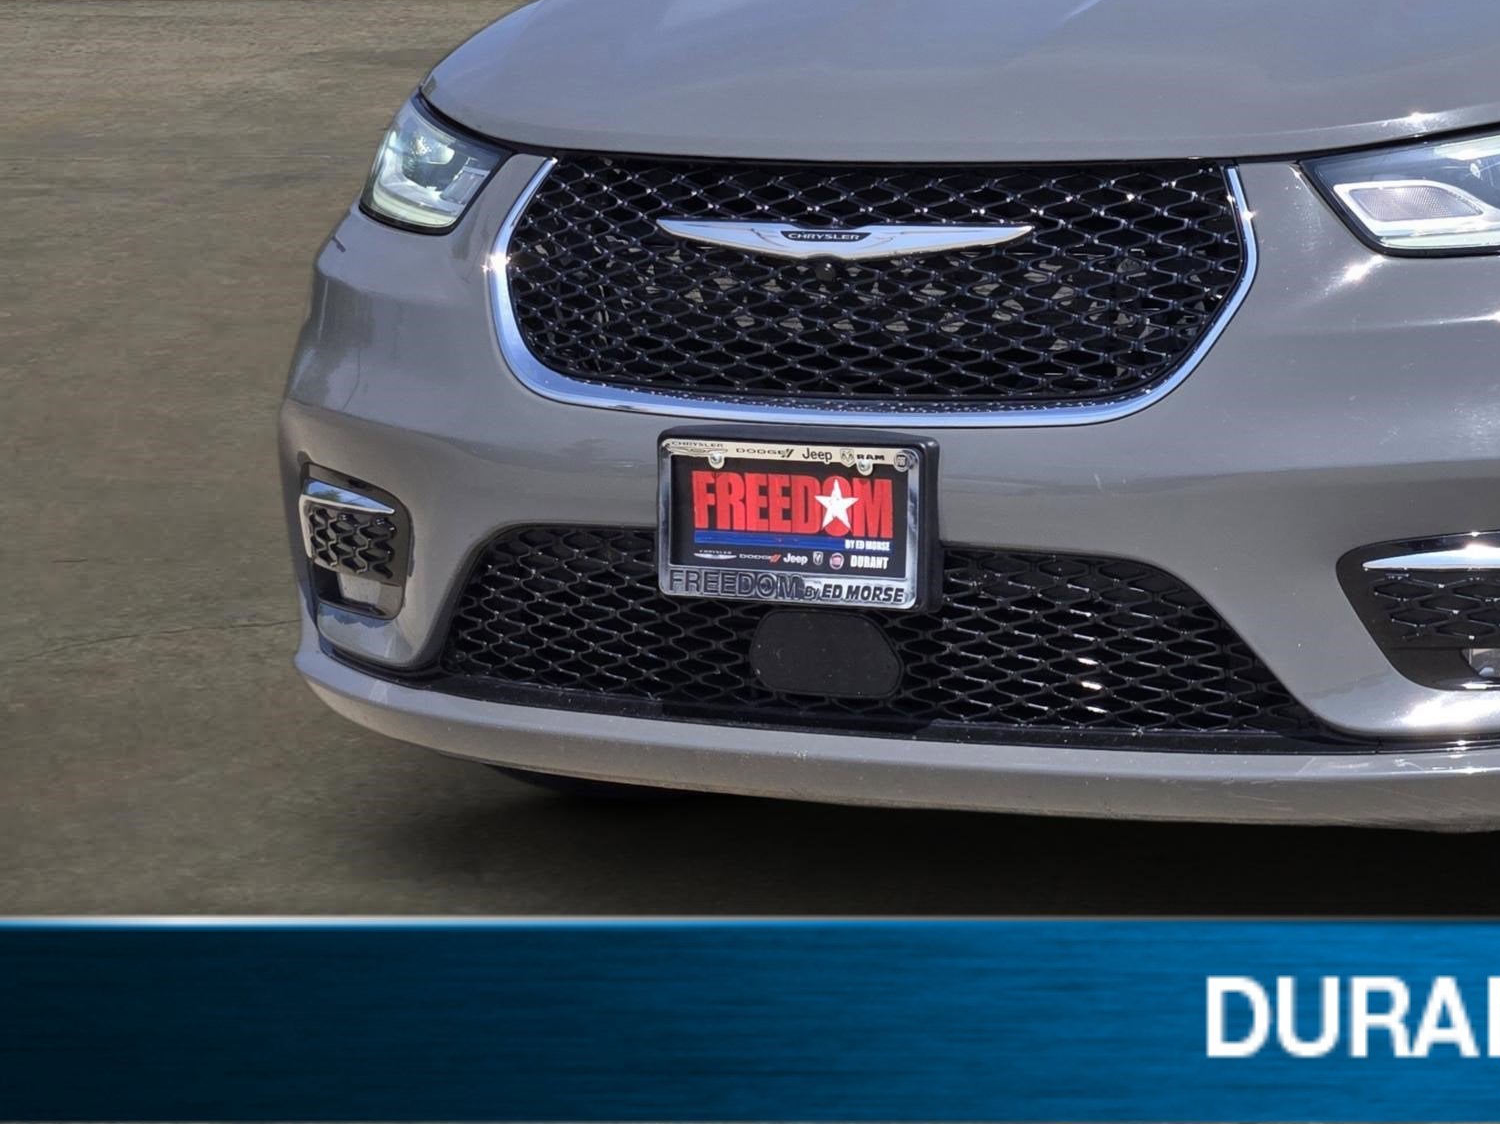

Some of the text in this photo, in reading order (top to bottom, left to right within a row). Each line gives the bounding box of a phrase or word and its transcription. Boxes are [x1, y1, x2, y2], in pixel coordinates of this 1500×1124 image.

[788, 233, 860, 241] CHRYSLER
[802, 447, 833, 463] Jeep
[692, 470, 894, 539] FREEDOM
[783, 552, 809, 566] Jeep
[849, 554, 890, 570] DURANT
[668, 569, 805, 601] FREEDOM
[821, 583, 843, 600] ED
[845, 584, 905, 604] MORSE
